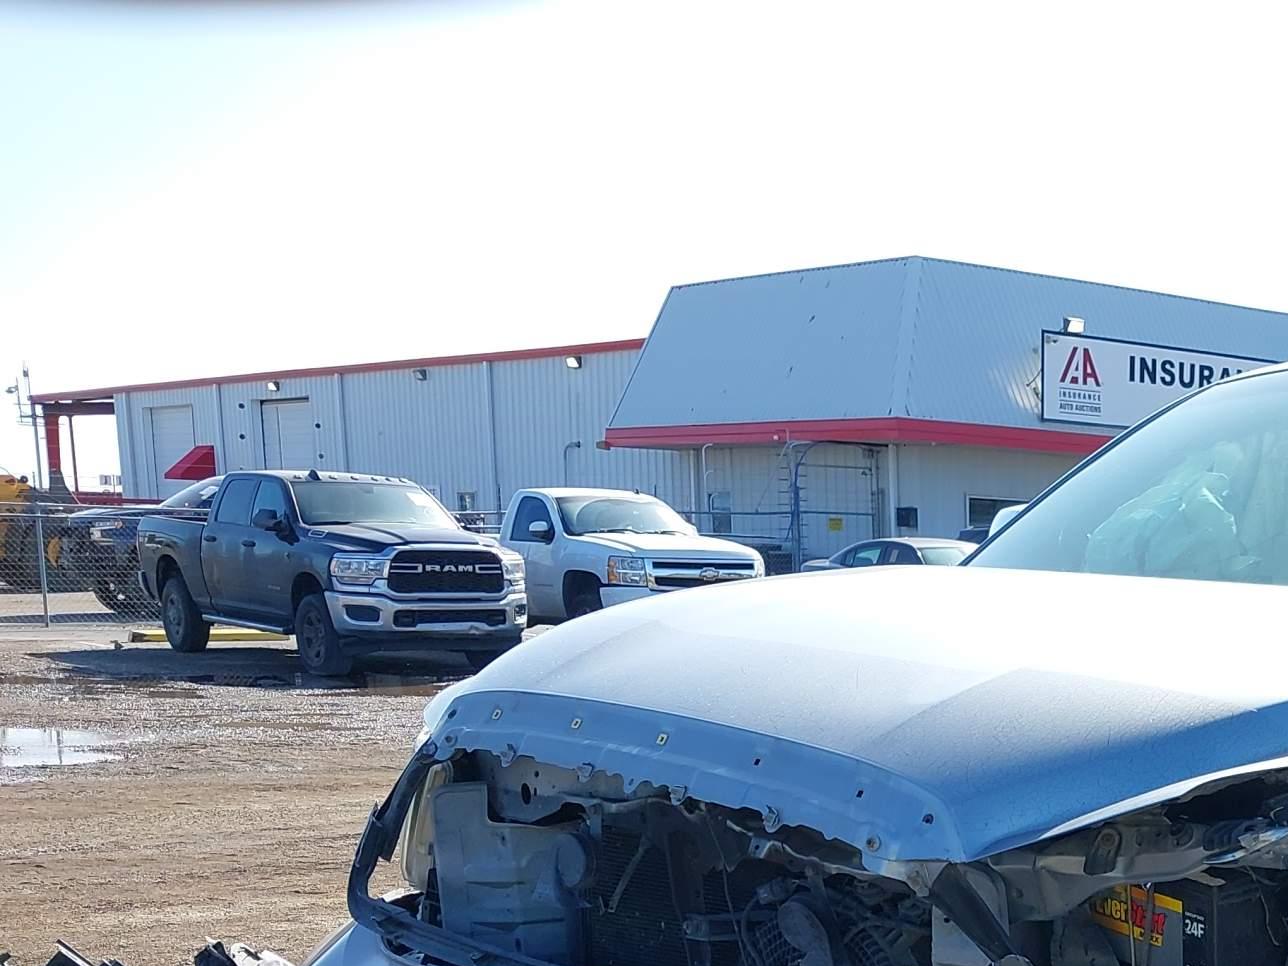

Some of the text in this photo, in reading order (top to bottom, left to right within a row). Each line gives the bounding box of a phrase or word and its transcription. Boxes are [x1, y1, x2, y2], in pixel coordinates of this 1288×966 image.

[1059, 390, 1101, 402] INSURANCE
[1059, 402, 1101, 414] AUTO AUCTIONS
[425, 564, 473, 572] RAM
[1184, 918, 1205, 938] 24F
